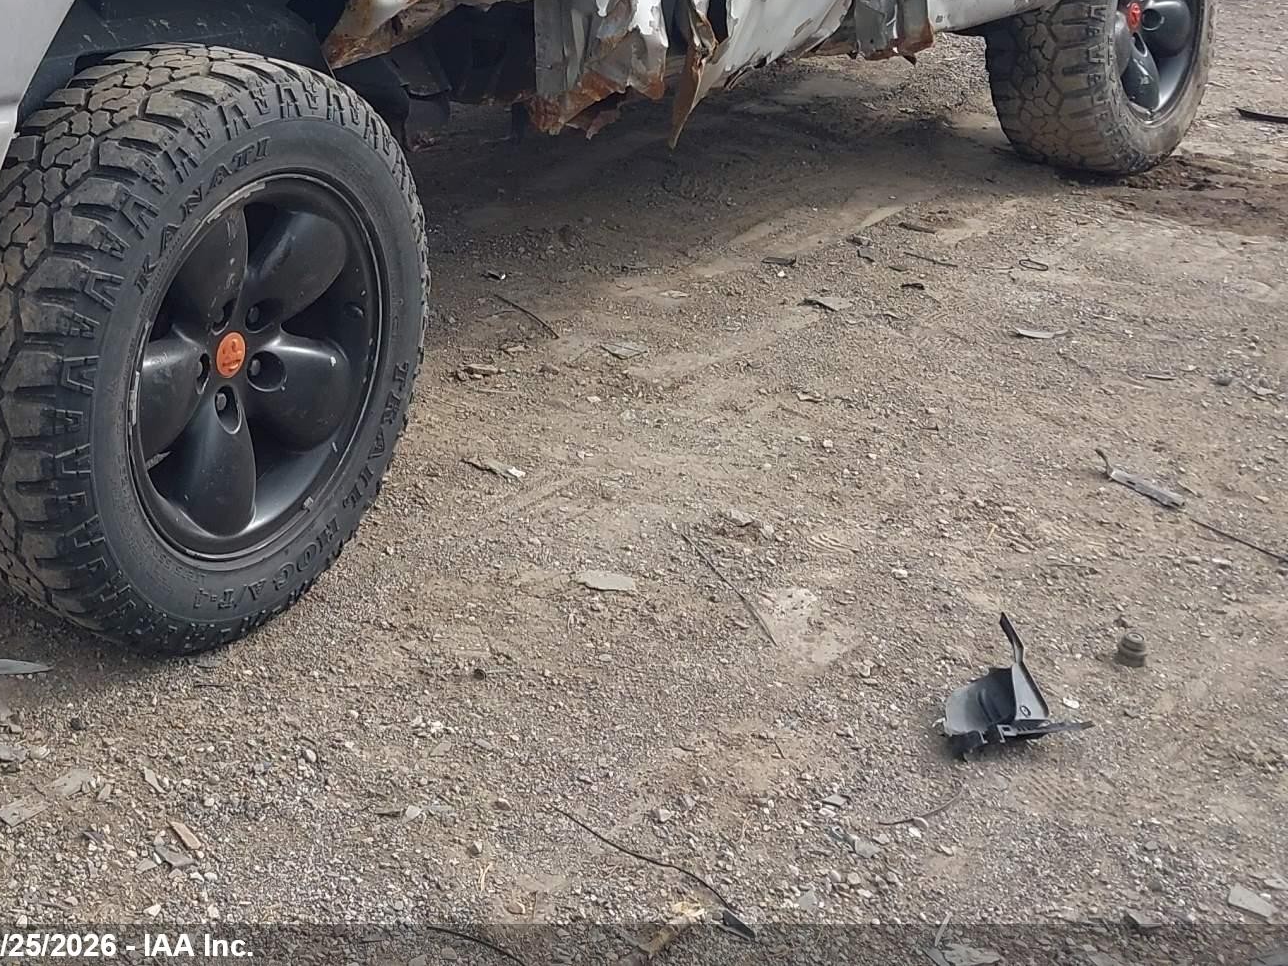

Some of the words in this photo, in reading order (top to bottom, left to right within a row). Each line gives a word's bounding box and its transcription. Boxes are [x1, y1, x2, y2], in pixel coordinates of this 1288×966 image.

[134, 136, 272, 295] KANATI
[341, 360, 410, 512] TRAIL
[272, 517, 341, 592] HOG
